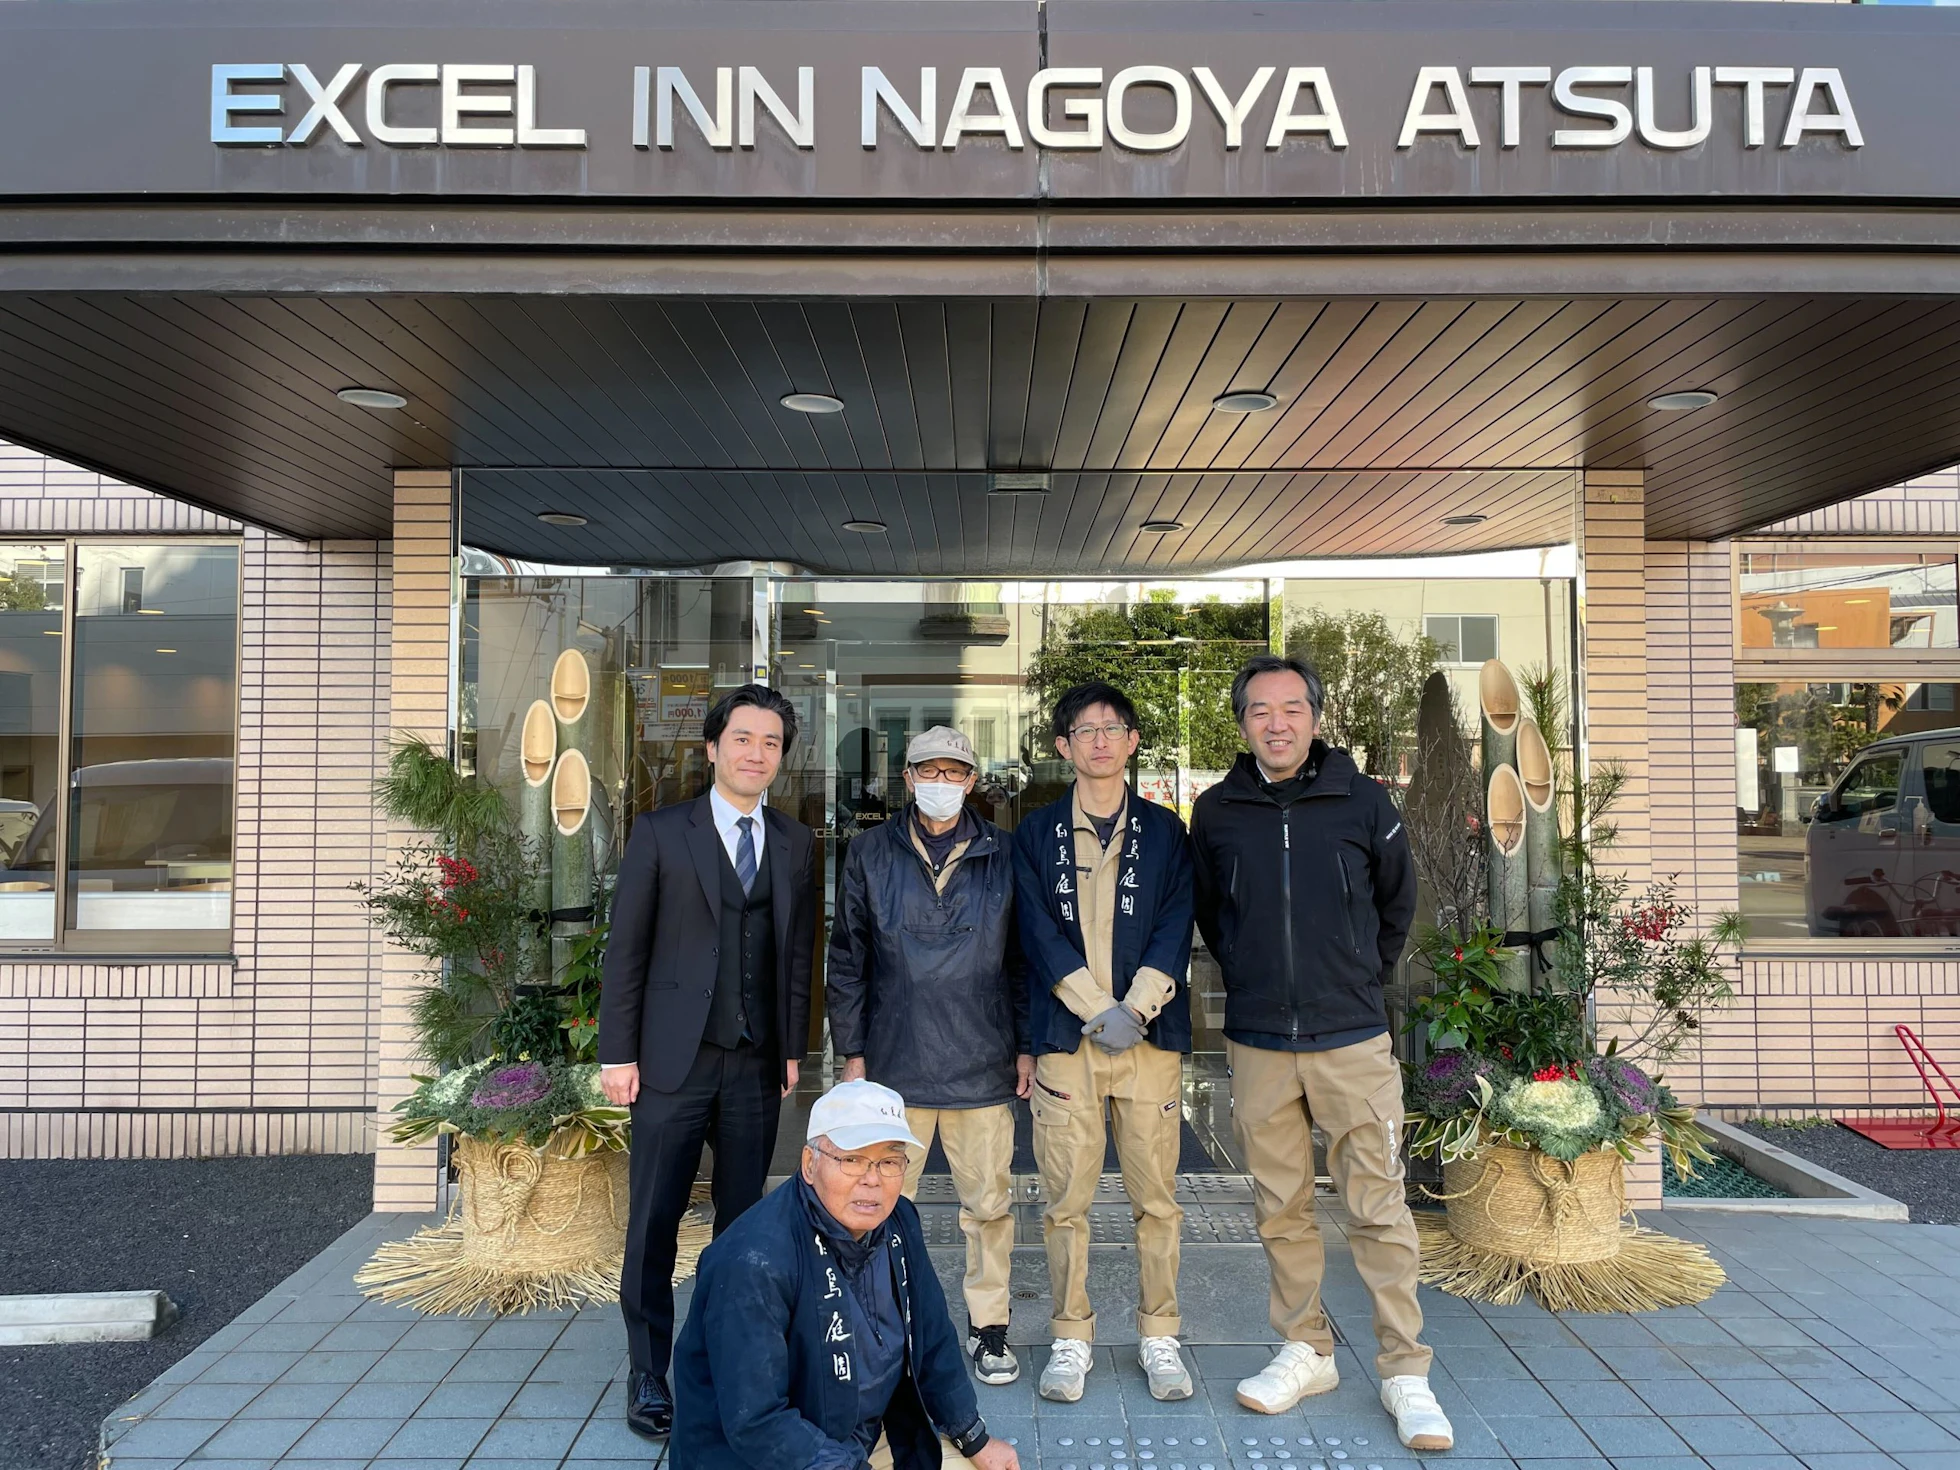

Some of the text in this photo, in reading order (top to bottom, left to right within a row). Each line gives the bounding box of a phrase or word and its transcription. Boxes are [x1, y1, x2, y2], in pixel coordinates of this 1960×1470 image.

[211, 63, 1864, 152] EXCEL INN NAGOYA ATSUTA
[1059, 764, 1076, 775] EX
[855, 812, 884, 821] EXCEL
[812, 828, 839, 838] CEL
